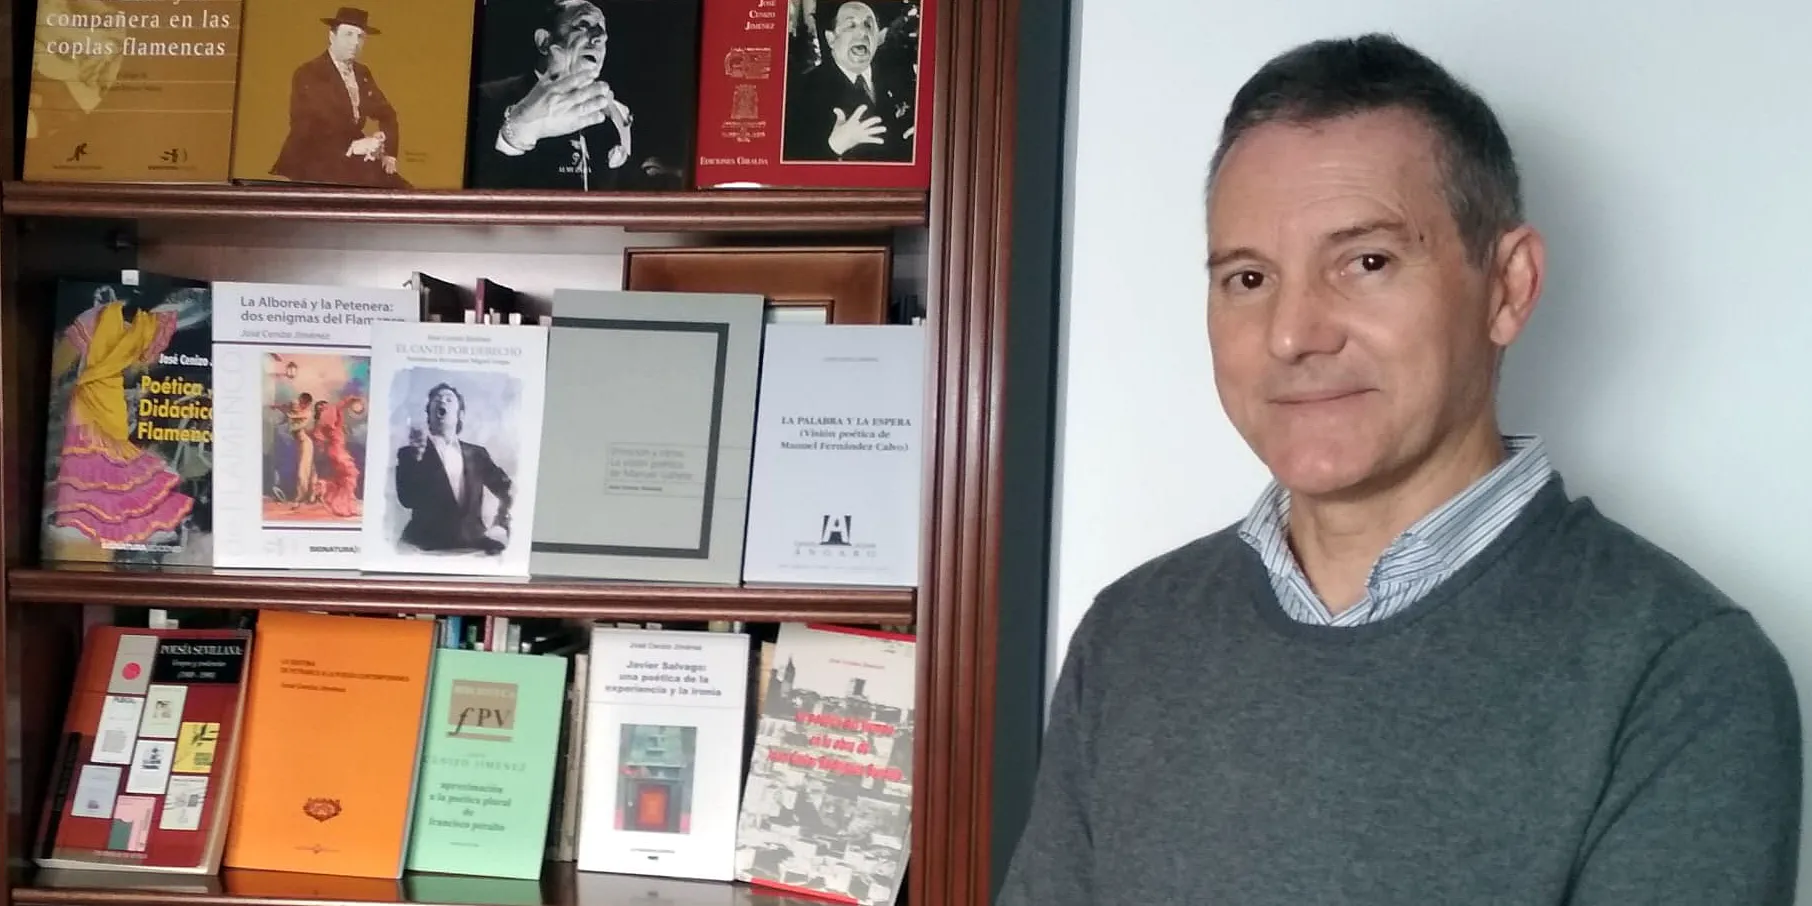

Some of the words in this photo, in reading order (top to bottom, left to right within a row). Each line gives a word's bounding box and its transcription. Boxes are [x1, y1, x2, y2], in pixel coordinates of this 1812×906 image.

[46, 11, 160, 33] compañera
[169, 14, 193, 28] en
[202, 10, 231, 29] las
[46, 36, 114, 59] coplas
[122, 37, 226, 56] flamencas
[240, 296, 255, 308] La
[310, 300, 320, 312] y
[320, 297, 332, 310] la
[335, 299, 394, 312] Petenera:
[240, 310, 264, 322] dos
[266, 312, 320, 326] enigmas
[323, 313, 342, 325] del
[159, 353, 179, 366] José
[179, 354, 208, 366] Cenizo
[141, 375, 203, 396] Poética
[781, 416, 794, 425] LA
[797, 416, 843, 425] PALABRA
[845, 417, 852, 425] Y
[856, 417, 869, 426] LA
[872, 417, 912, 427] ESPERA
[838, 429, 875, 440] poética
[878, 430, 891, 439] de
[781, 441, 818, 450] Manuel
[626, 660, 659, 669] Javier
[619, 673, 639, 681] una
[683, 674, 696, 683] de
[699, 675, 709, 683] la
[678, 686, 689, 695] la
